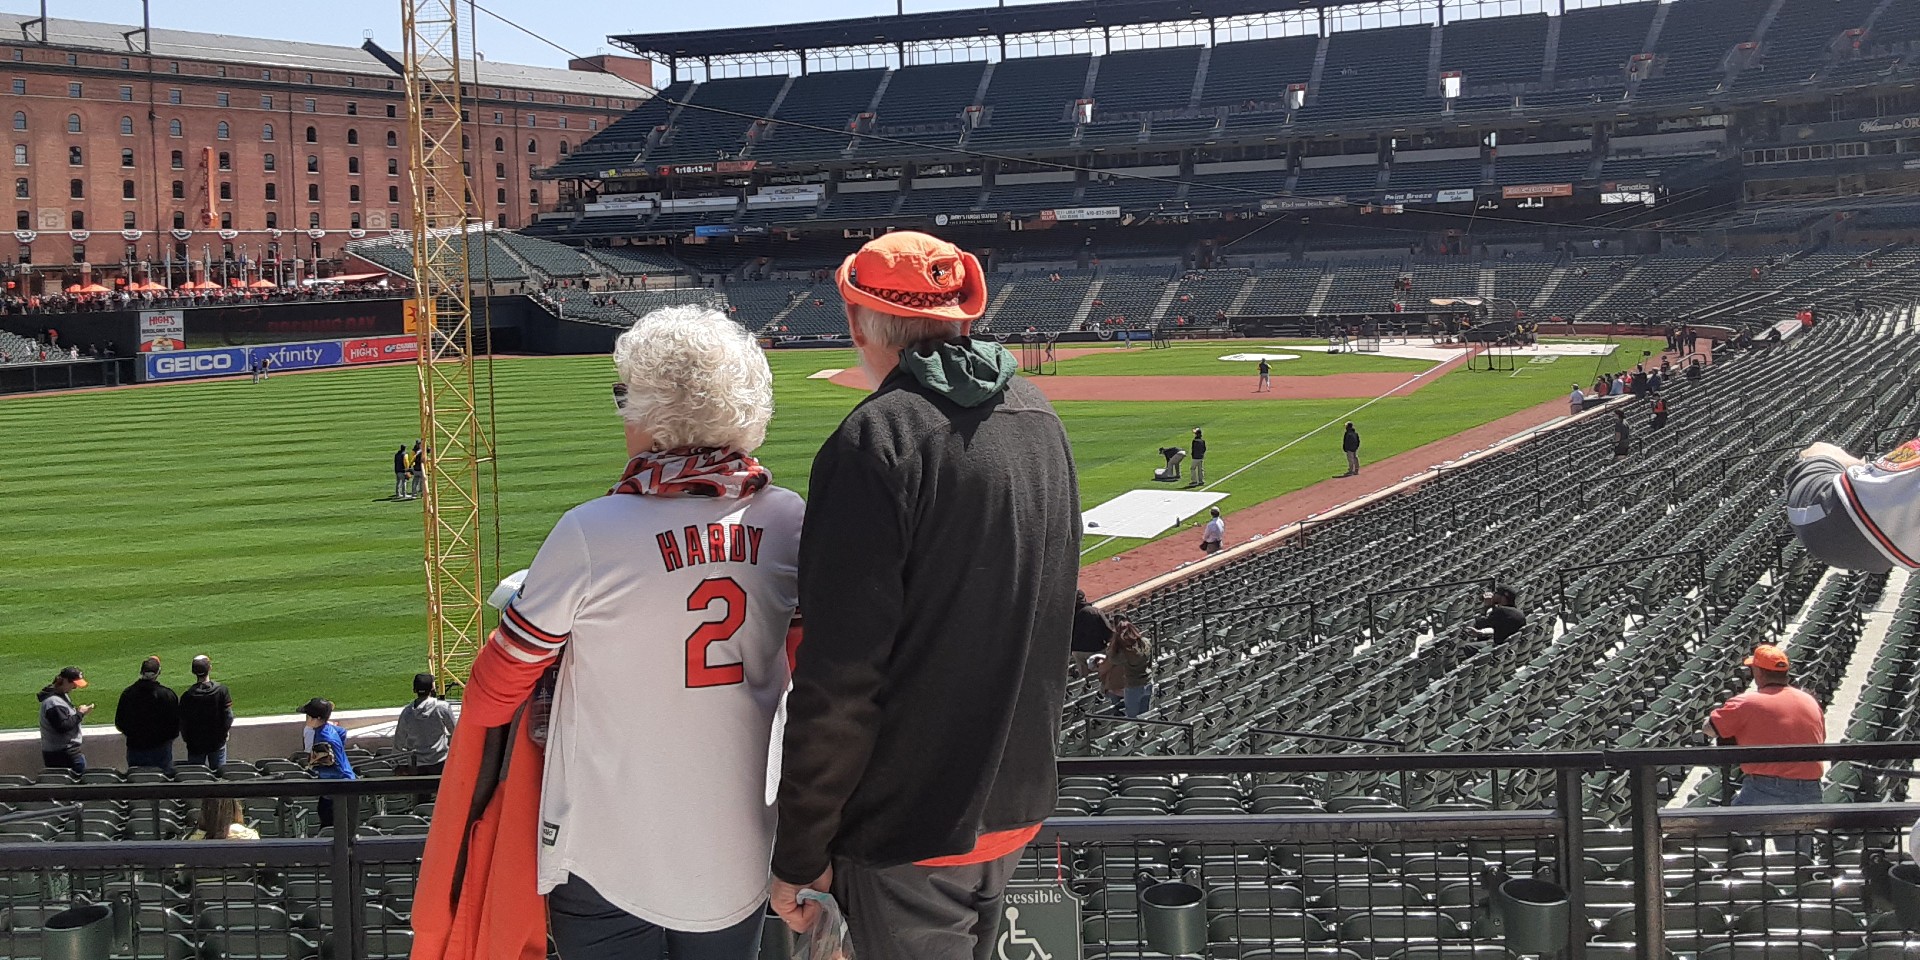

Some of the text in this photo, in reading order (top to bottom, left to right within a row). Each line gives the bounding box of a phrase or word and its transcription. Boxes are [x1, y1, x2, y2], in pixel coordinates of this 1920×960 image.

[1859, 118, 1894, 132] Welcome
[1616, 183, 1650, 191] Fanatics
[149, 316, 175, 325] HIGH'S
[269, 346, 323, 366] xfinity
[350, 347, 379, 359] HIGH'S
[156, 354, 231, 373] GEICO
[656, 523, 763, 572] HARDY
[685, 576, 747, 688] 2
[1004, 890, 1062, 904] cessible
